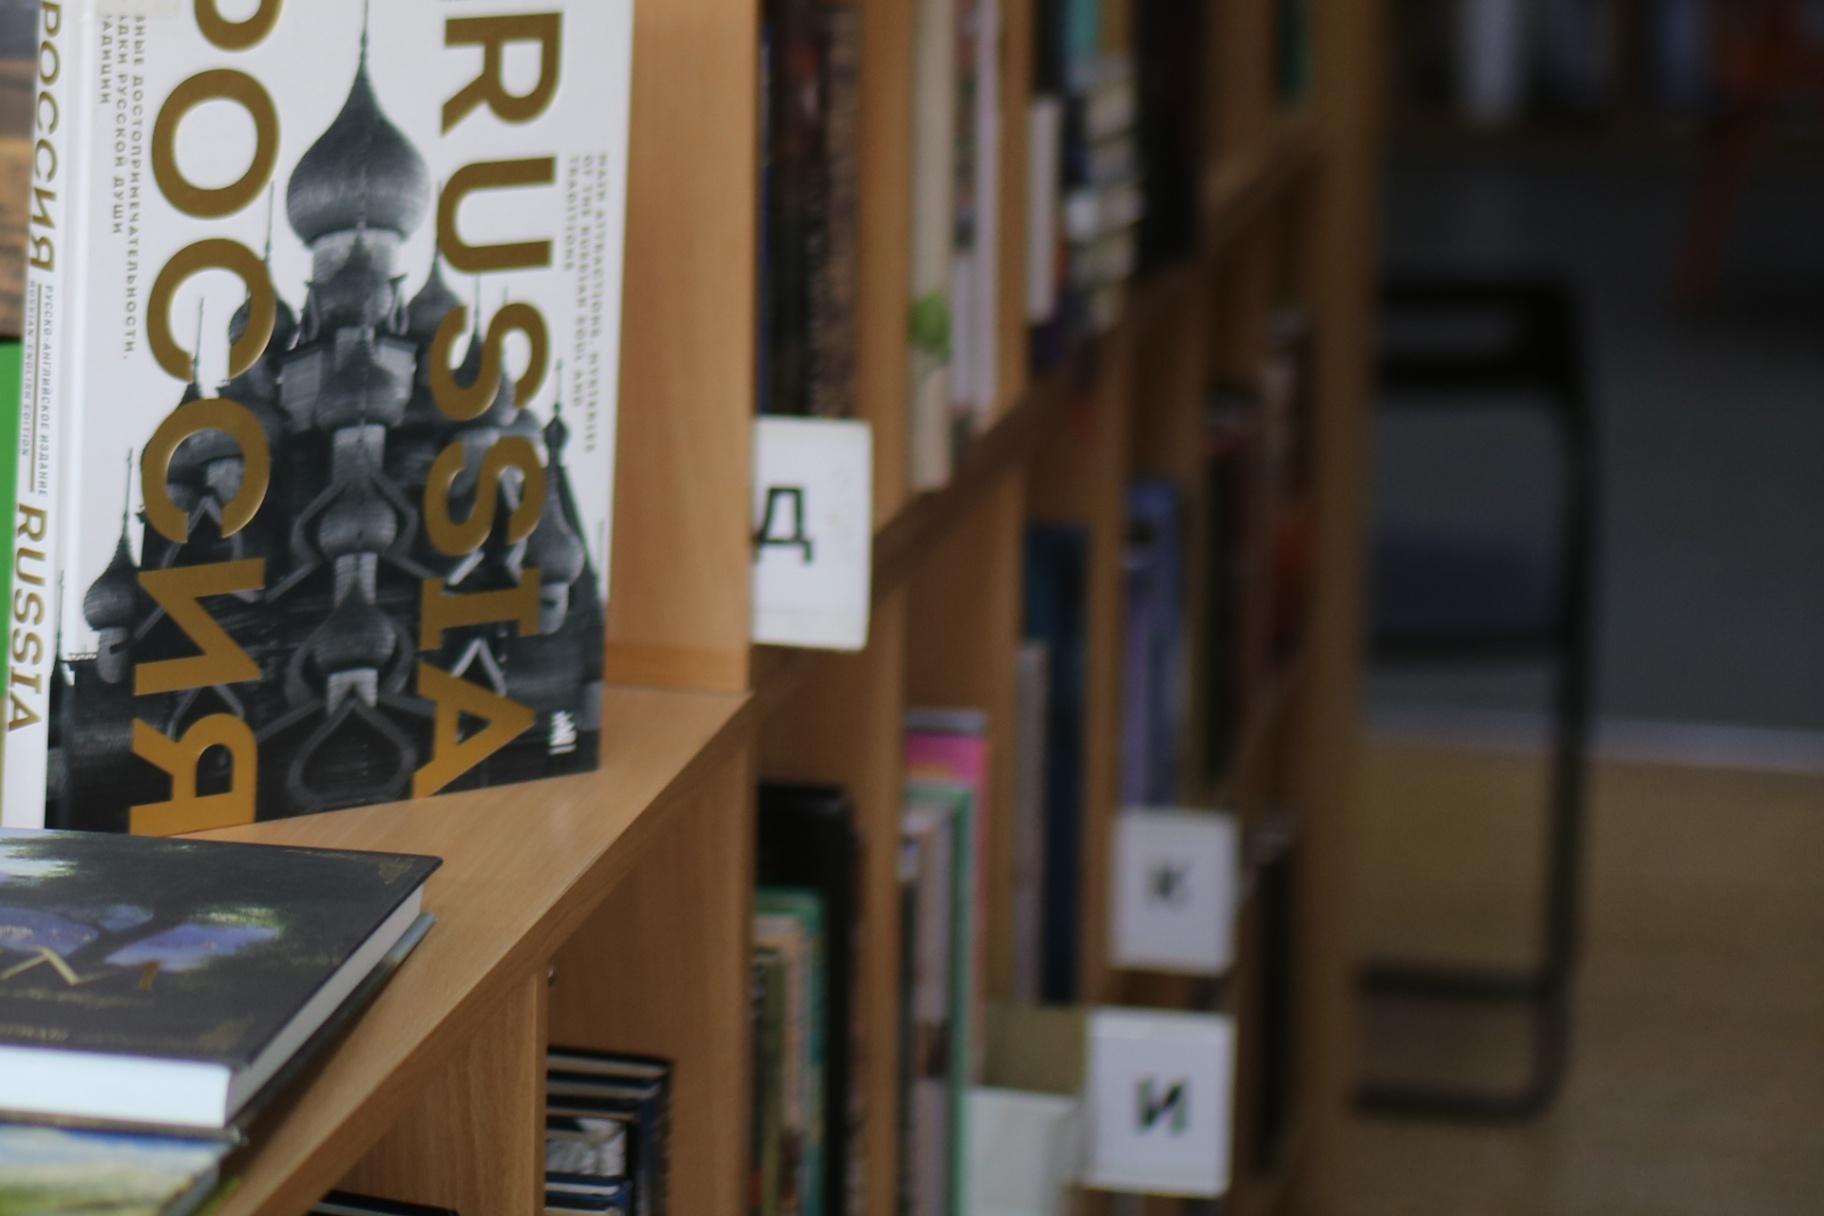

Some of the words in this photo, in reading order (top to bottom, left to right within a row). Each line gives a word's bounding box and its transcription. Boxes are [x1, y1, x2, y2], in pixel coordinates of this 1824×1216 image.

[100, 15, 114, 104] АДИЦИИ
[29, 0, 62, 272] РОССИЯ
[114, 74, 129, 167] РУССКОЙ
[111, 176, 125, 235] ДУШИ
[412, 11, 563, 800] RUSSIA
[753, 486, 813, 563] Д
[7, 502, 48, 733] RUSSIA
[1135, 1077, 1186, 1137] И
